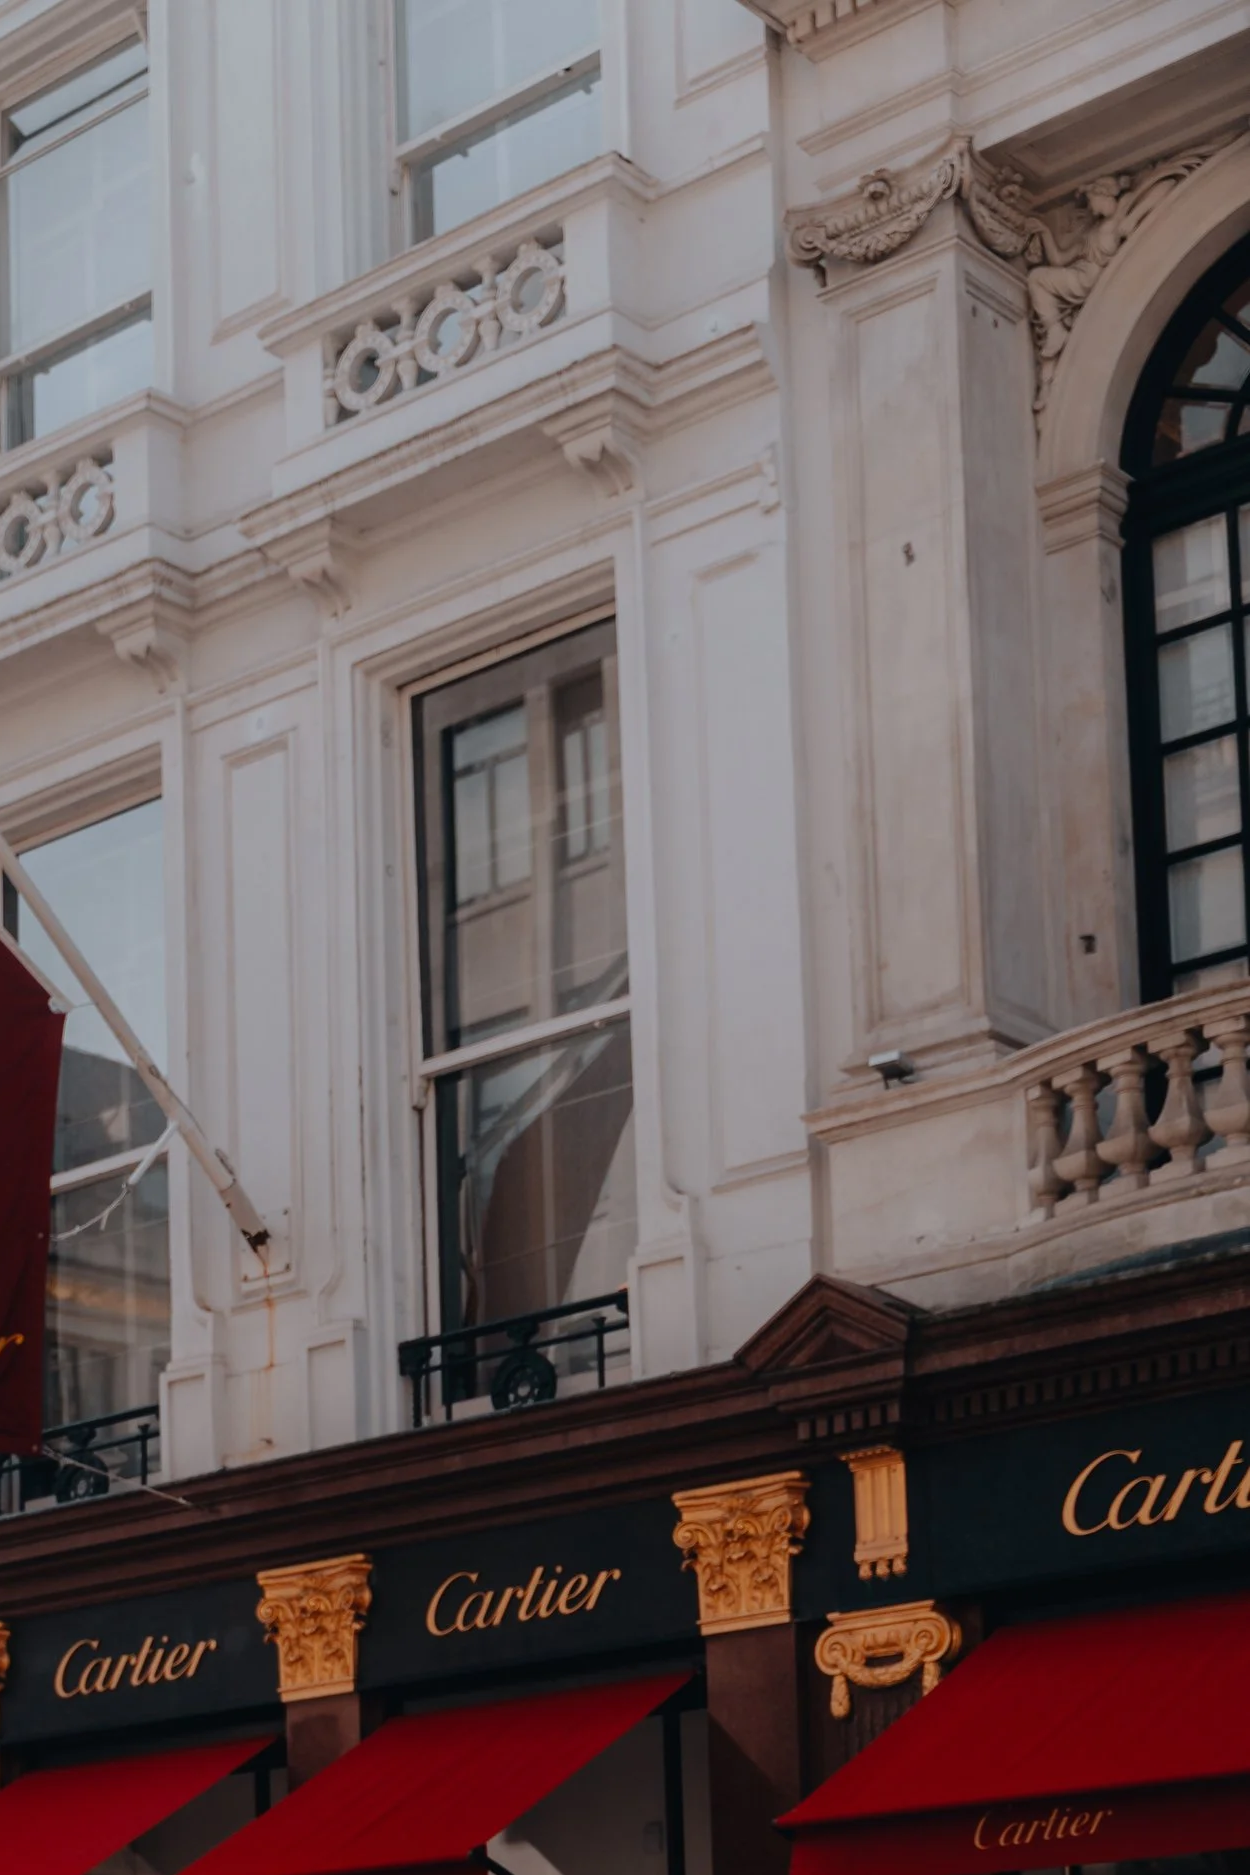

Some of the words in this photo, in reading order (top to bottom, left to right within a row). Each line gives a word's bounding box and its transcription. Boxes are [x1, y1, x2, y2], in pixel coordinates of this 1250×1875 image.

[424, 1562, 622, 1638] Cartier
[53, 1634, 217, 1699] Cartier
[972, 1806, 1115, 1851] Cartier
